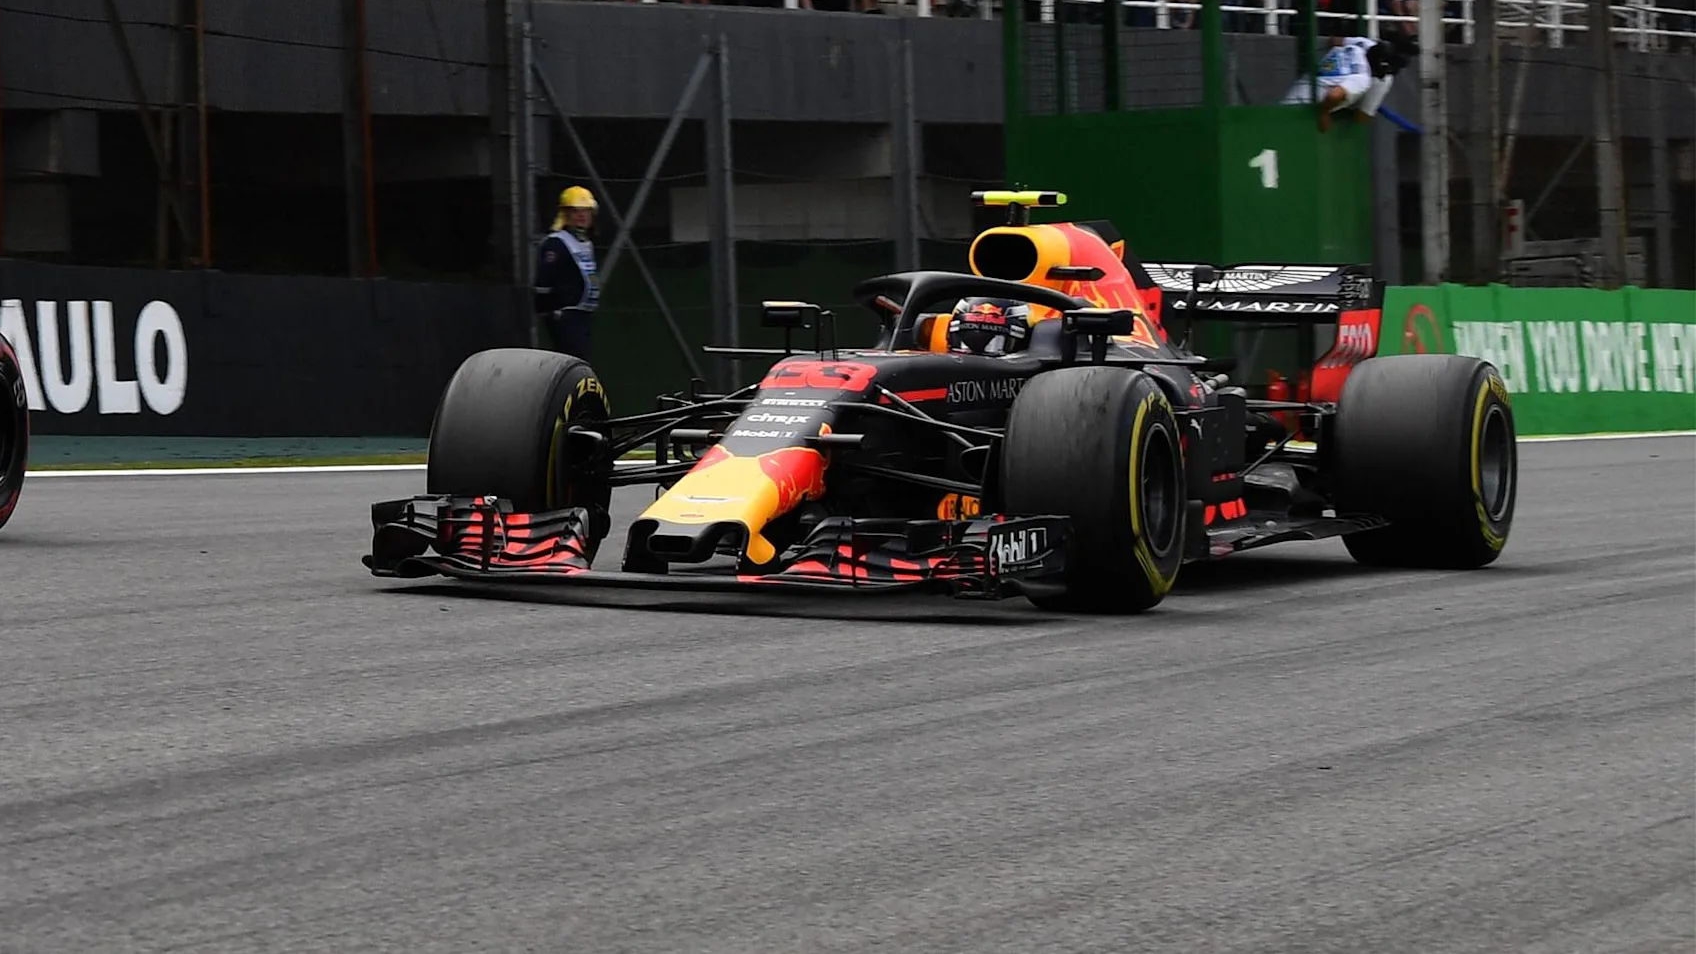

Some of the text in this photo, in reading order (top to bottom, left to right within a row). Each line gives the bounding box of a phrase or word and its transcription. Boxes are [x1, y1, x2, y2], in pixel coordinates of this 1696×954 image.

[1249, 149, 1279, 188] 1
[1223, 272, 1268, 281] MARTIN
[1526, 321, 1581, 393] YOU
[1581, 320, 1652, 392] DRIVE
[947, 381, 986, 403] ASTON
[761, 398, 827, 407] PIRELLI
[732, 429, 780, 438] Mobil
